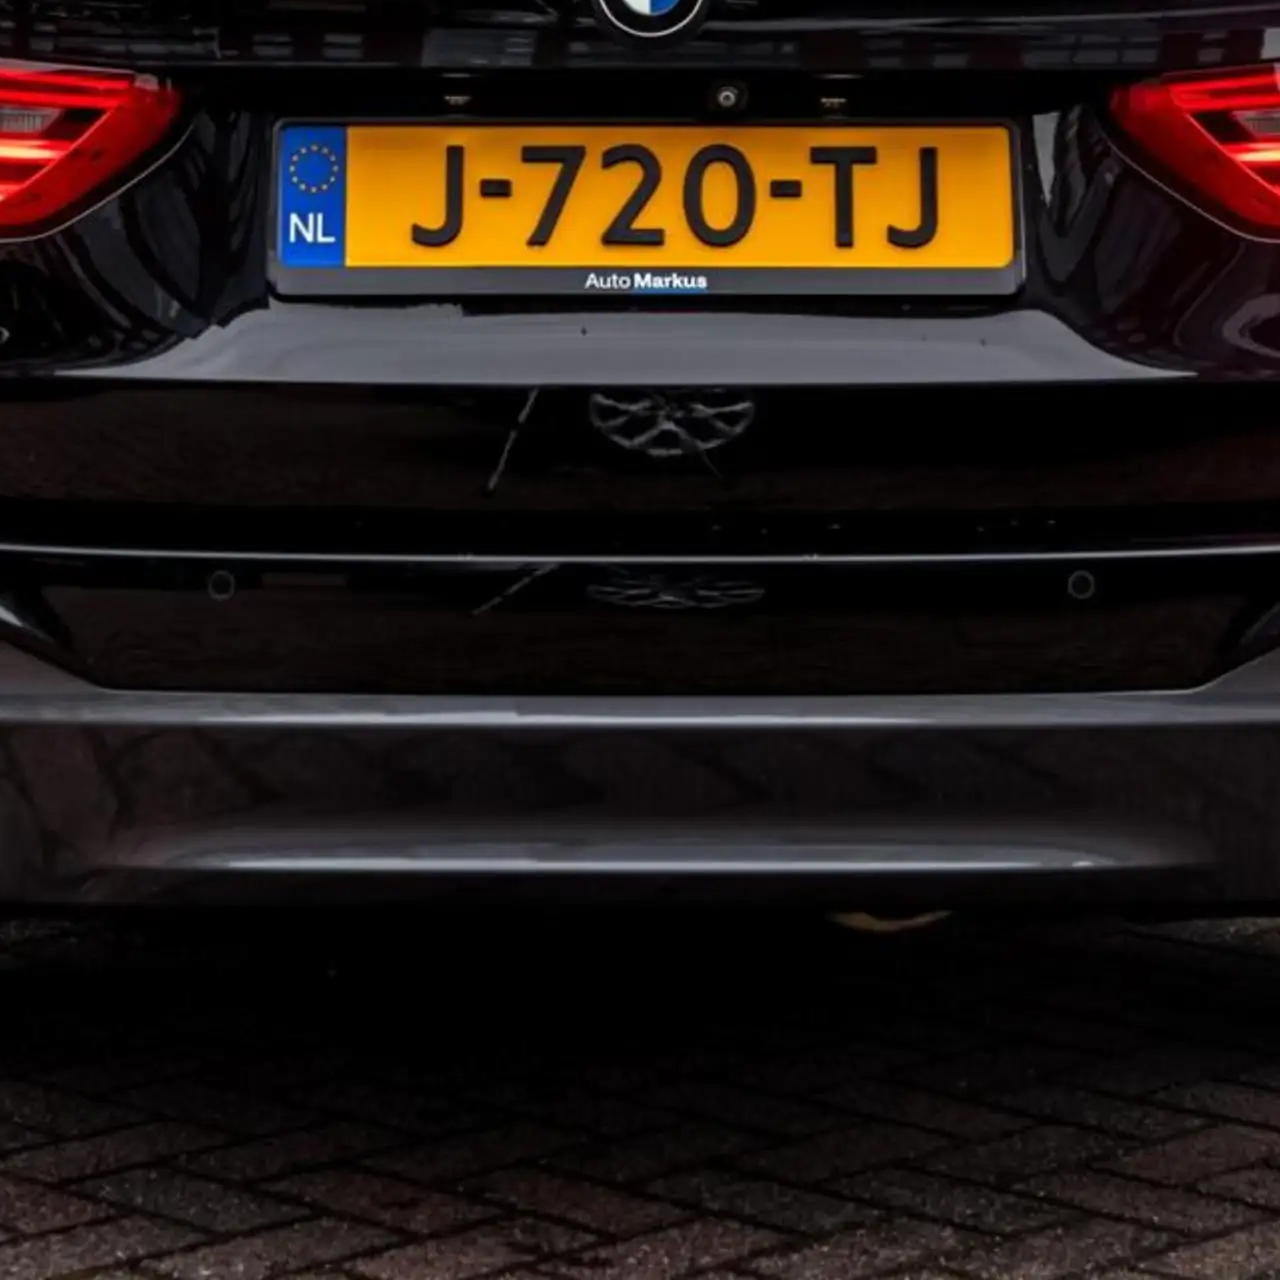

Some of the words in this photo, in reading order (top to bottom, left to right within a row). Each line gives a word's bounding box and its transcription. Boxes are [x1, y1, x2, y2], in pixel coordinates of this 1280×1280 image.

[410, 144, 940, 250] J-720-TJ
[288, 212, 336, 244] NL
[584, 271, 631, 290] Auto
[633, 271, 708, 290] Markus
